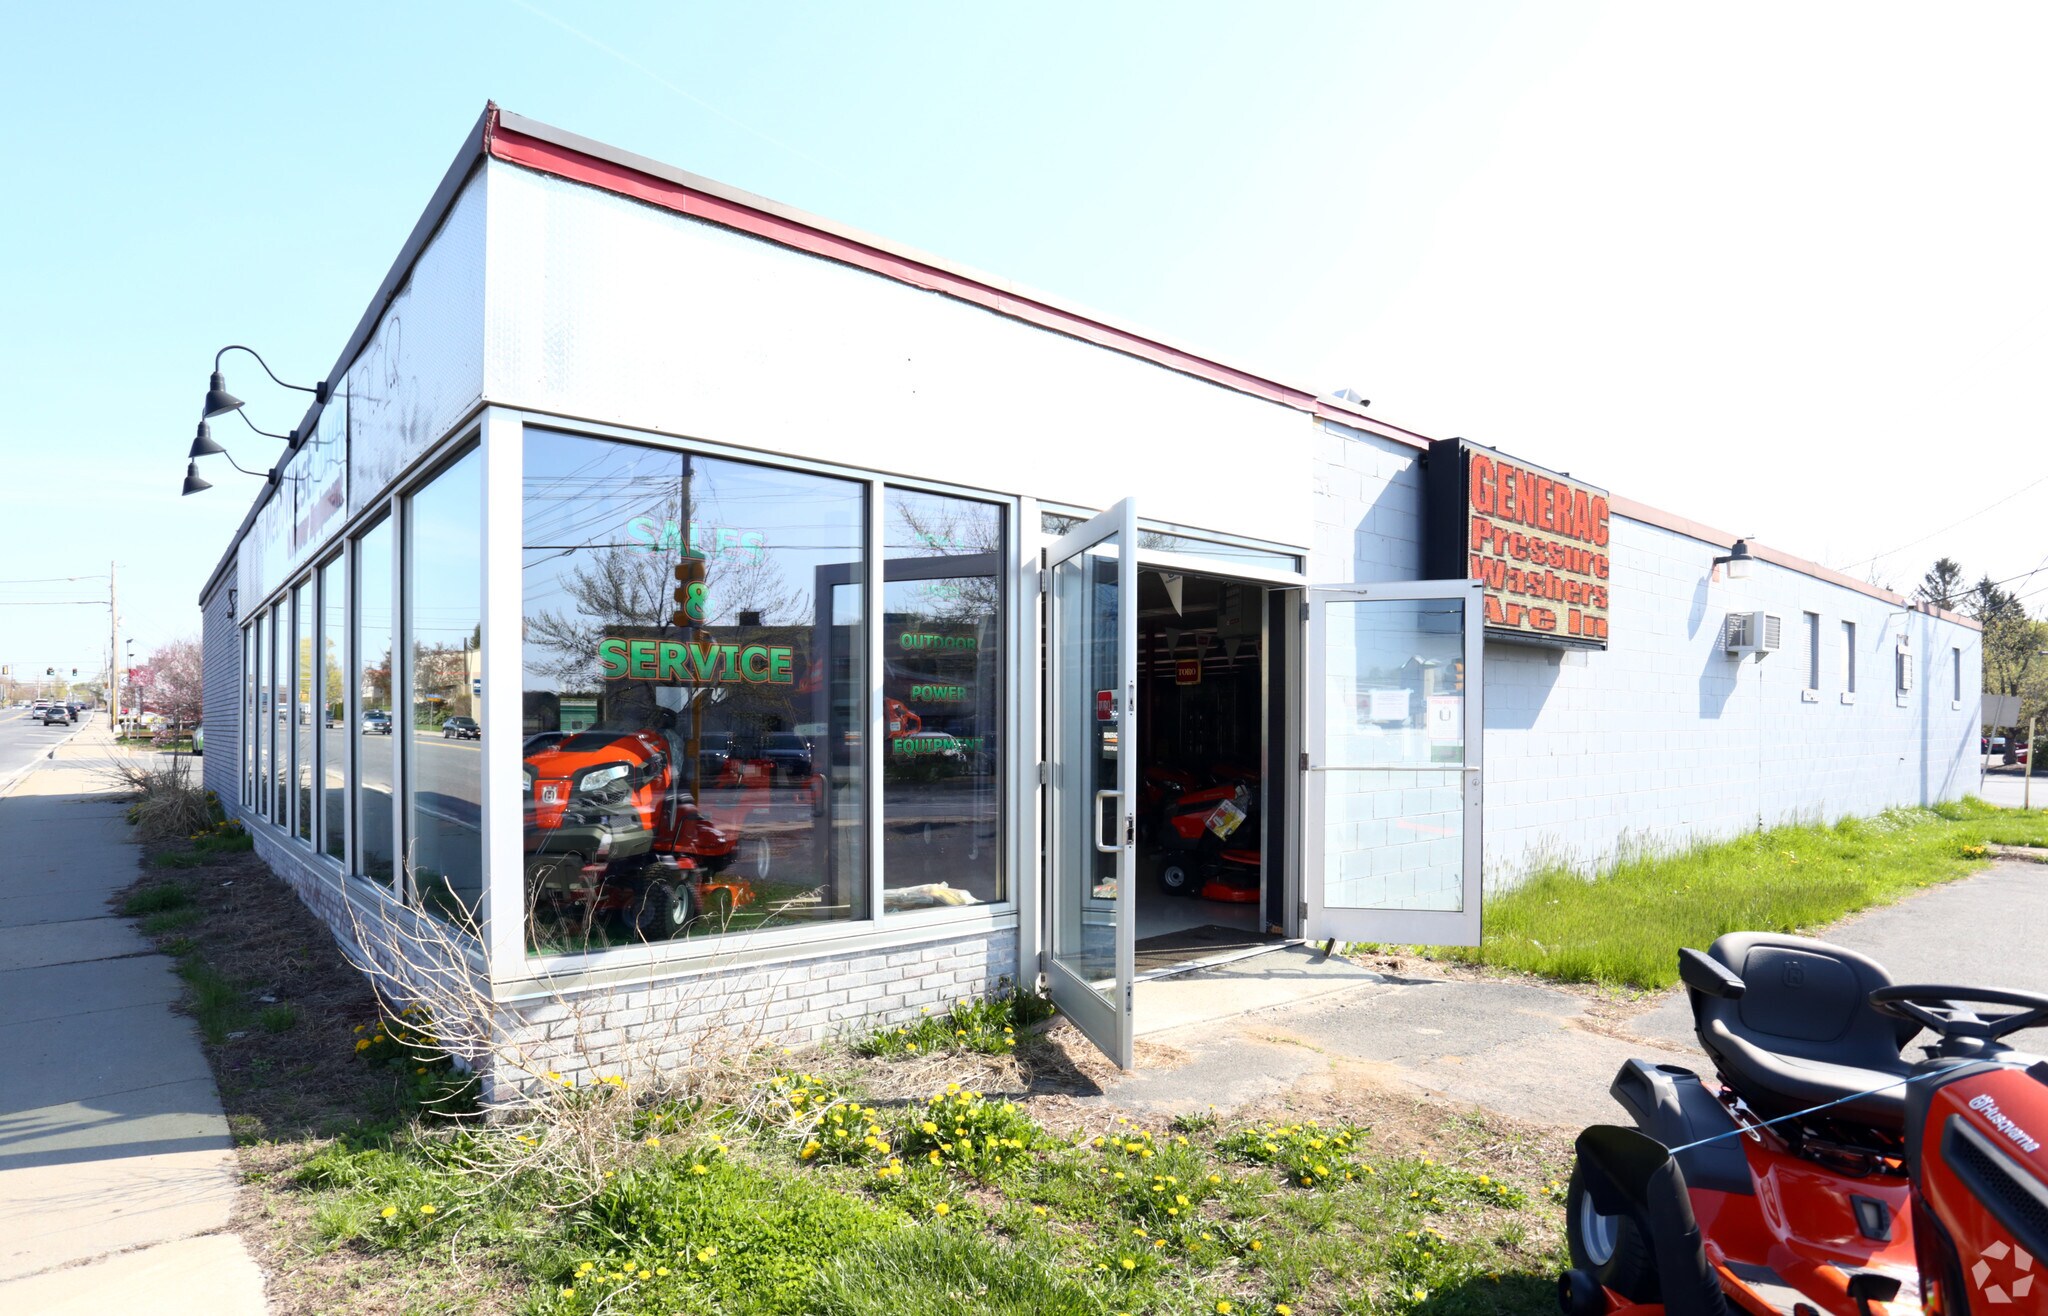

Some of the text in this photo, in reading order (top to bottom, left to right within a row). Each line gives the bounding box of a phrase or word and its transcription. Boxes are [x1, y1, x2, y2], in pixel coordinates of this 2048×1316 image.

[1470, 453, 1609, 547] GENERAC
[623, 516, 768, 567] SALES
[1470, 515, 1609, 580] Pressure
[684, 580, 716, 623] &
[1470, 553, 1608, 609] Washers
[1484, 594, 1608, 639] Are In
[598, 637, 793, 684] SERVICE
[900, 632, 978, 651] OUTDOOR
[911, 684, 968, 701] POWER
[1178, 667, 1196, 676] TORO
[893, 738, 984, 757] EQUIPMENT
[1979, 1103, 2040, 1153] Husqvarna
